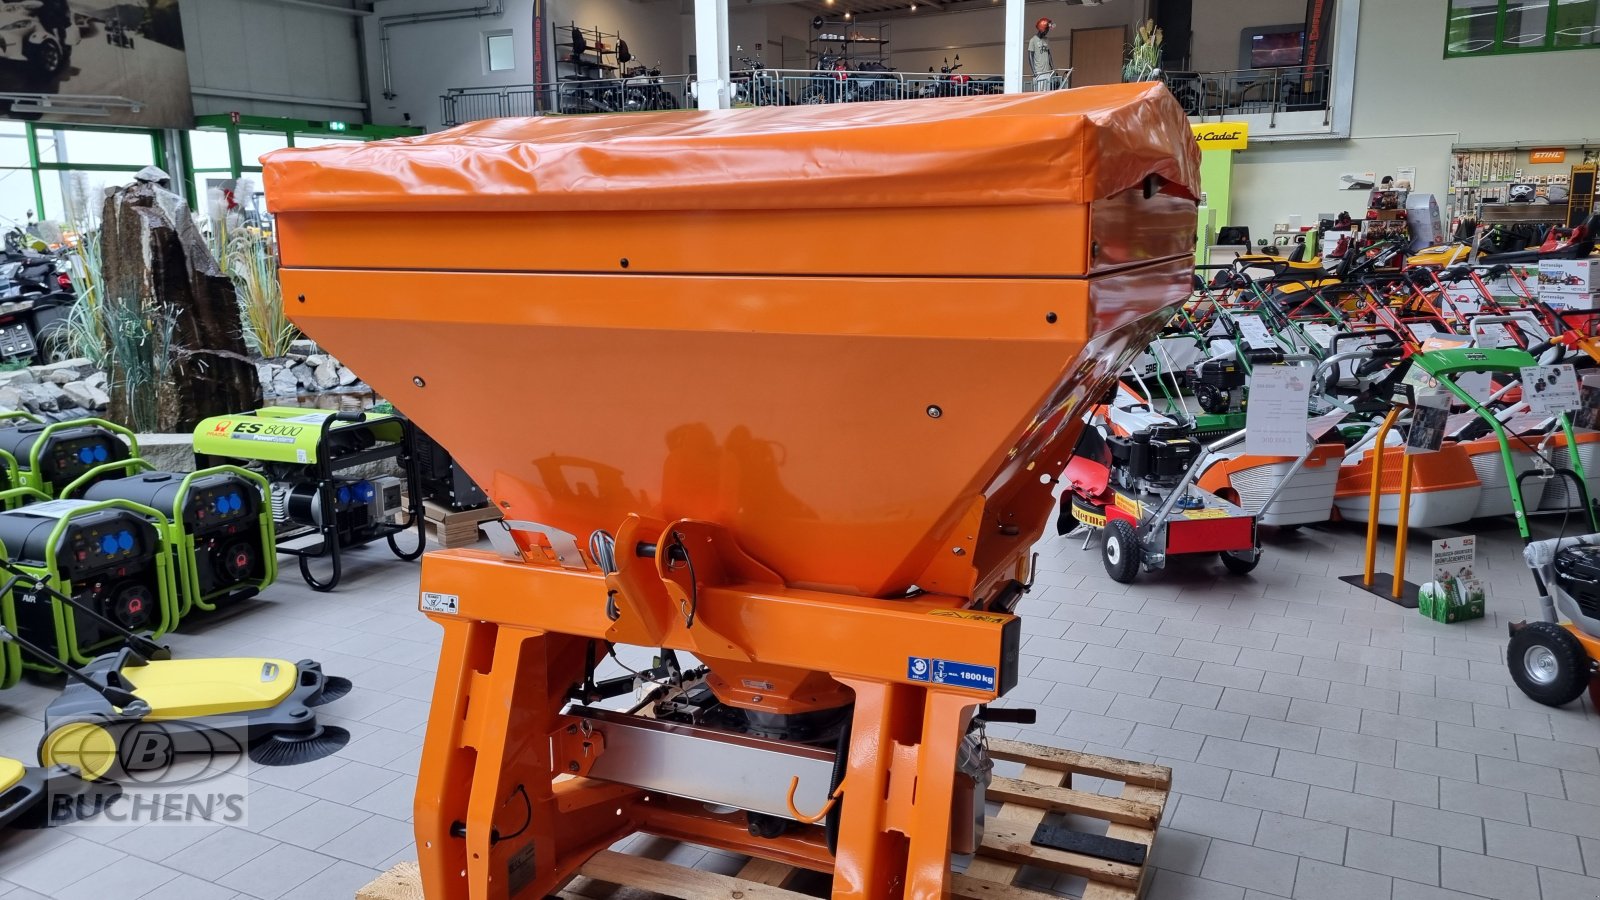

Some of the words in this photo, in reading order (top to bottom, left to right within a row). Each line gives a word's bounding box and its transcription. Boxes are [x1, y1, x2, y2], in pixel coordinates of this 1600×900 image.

[1203, 131, 1242, 141] Cadet
[1533, 151, 1561, 159] STIHL
[1145, 362, 1158, 374] SAB
[233, 422, 263, 434] ES
[264, 424, 303, 437] 8000
[960, 671, 982, 681] 1800
[982, 674, 993, 685] kg
